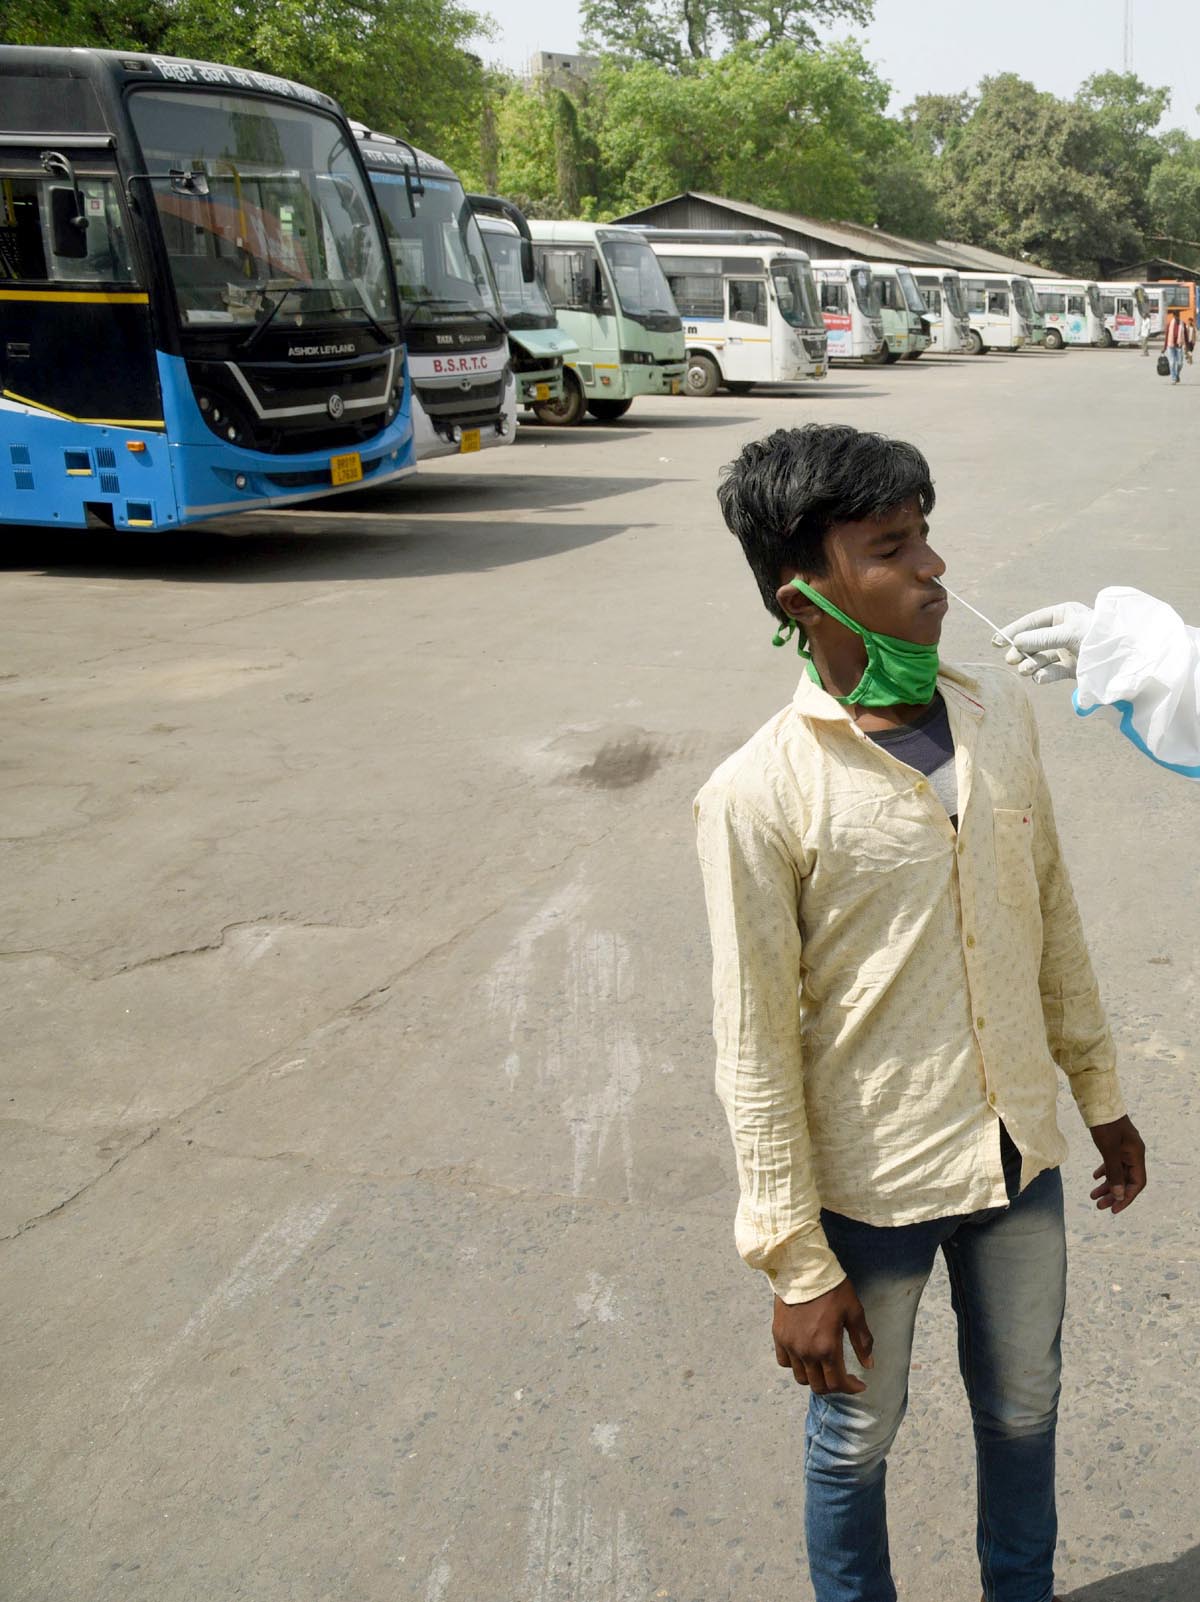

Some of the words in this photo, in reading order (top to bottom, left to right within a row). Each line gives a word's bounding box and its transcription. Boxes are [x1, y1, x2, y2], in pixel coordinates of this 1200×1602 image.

[152, 58, 197, 82] बिहार
[195, 65, 230, 84] राज्य
[288, 346, 319, 356] ASHOK
[320, 344, 355, 354] LEYLAND
[433, 356, 488, 373] B.S.R.T.C
